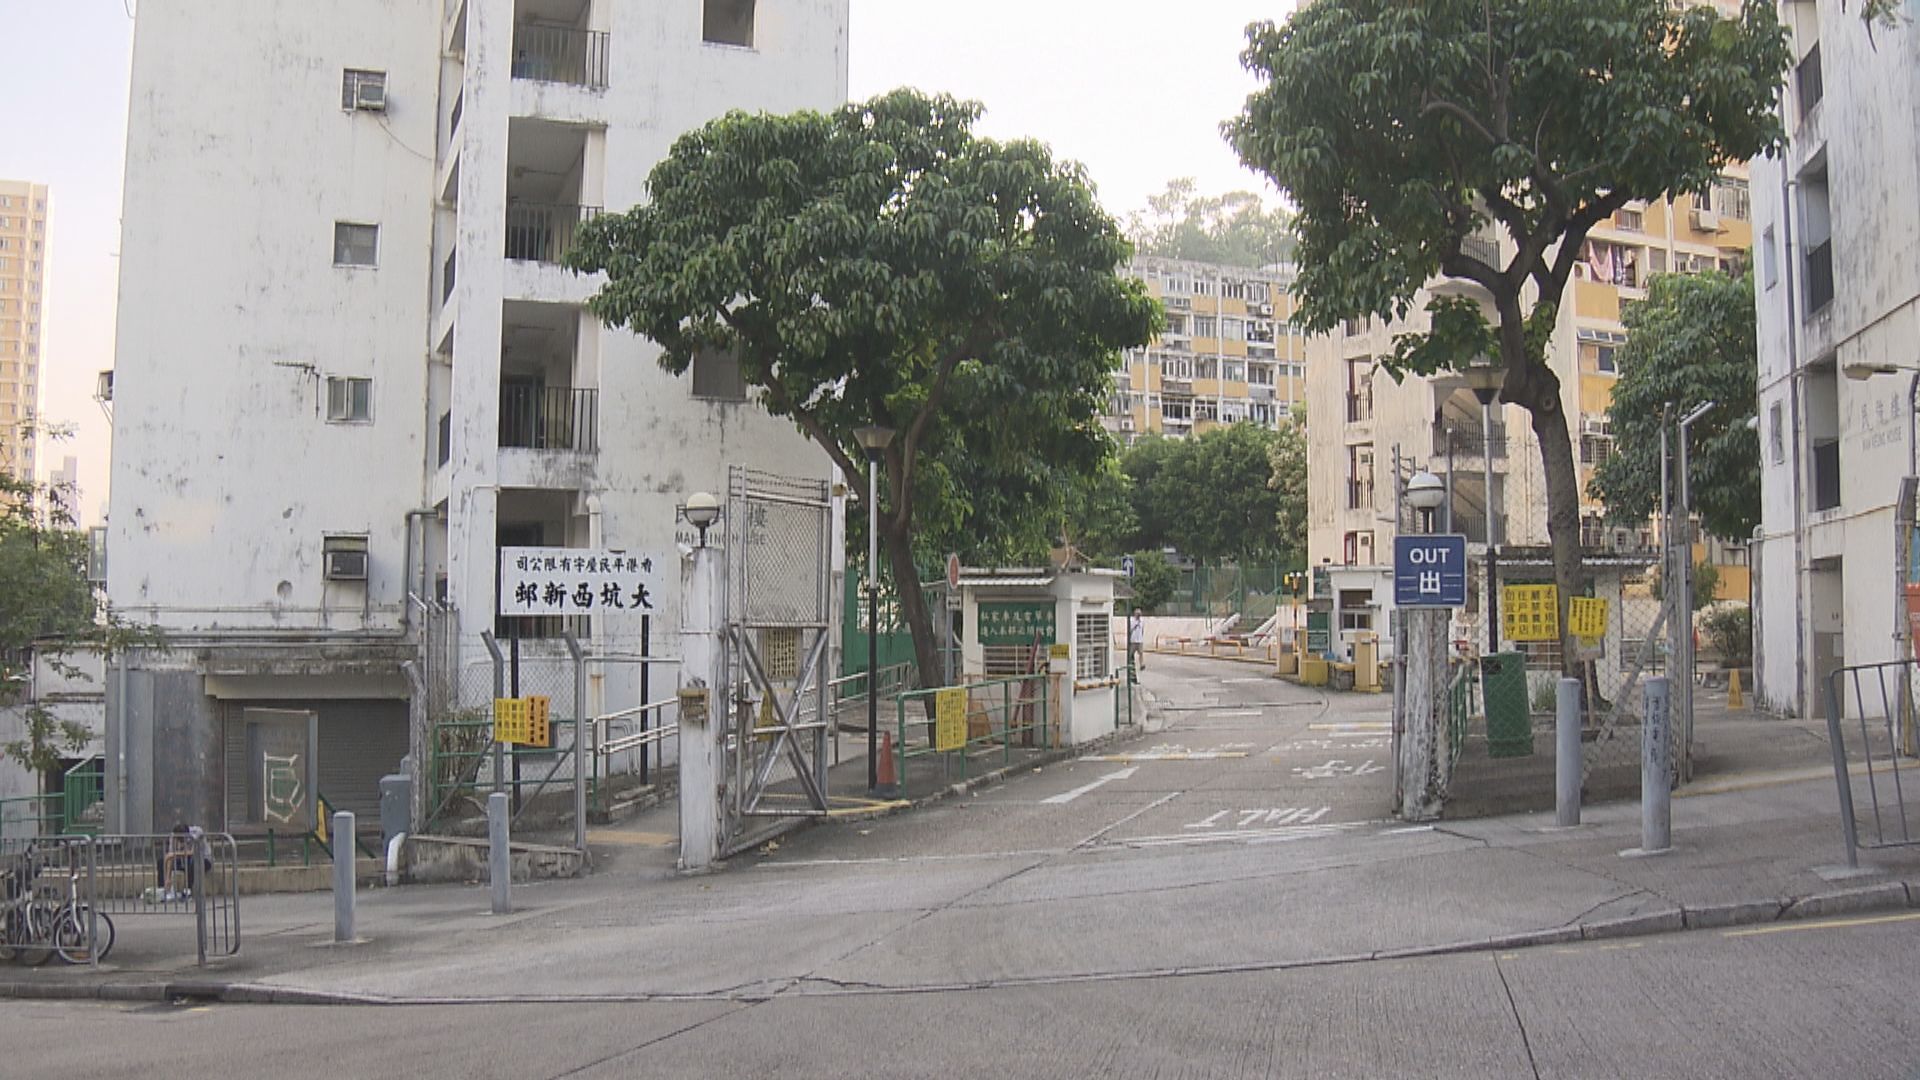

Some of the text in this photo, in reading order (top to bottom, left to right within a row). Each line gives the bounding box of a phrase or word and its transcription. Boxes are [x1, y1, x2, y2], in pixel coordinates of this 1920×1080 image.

[1410, 548, 1450, 563] OUT
[1420, 570, 1440, 593] 出
[515, 580, 653, 609] 大坑西新邨
[1184, 806, 1331, 828] HALT
